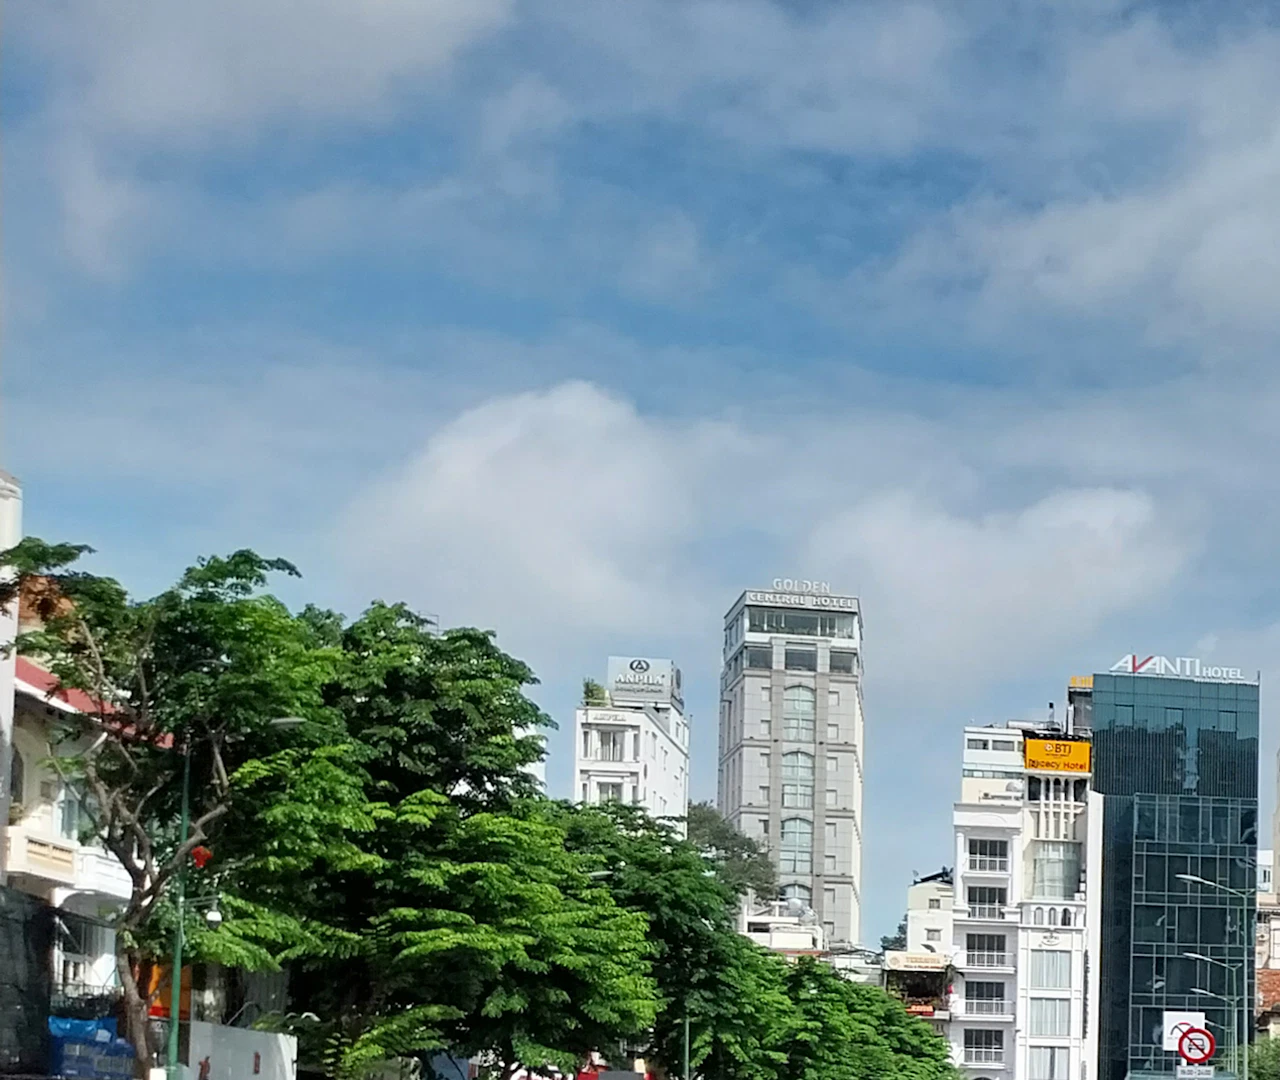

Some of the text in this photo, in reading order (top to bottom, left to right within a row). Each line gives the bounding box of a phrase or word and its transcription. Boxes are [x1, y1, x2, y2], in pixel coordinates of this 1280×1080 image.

[773, 578, 830, 594] GOLDEN
[749, 592, 852, 608] CENTRAL HOTEL
[1109, 654, 1245, 680] AVANTI HOTEL
[1063, 761, 1087, 770] Hotel
